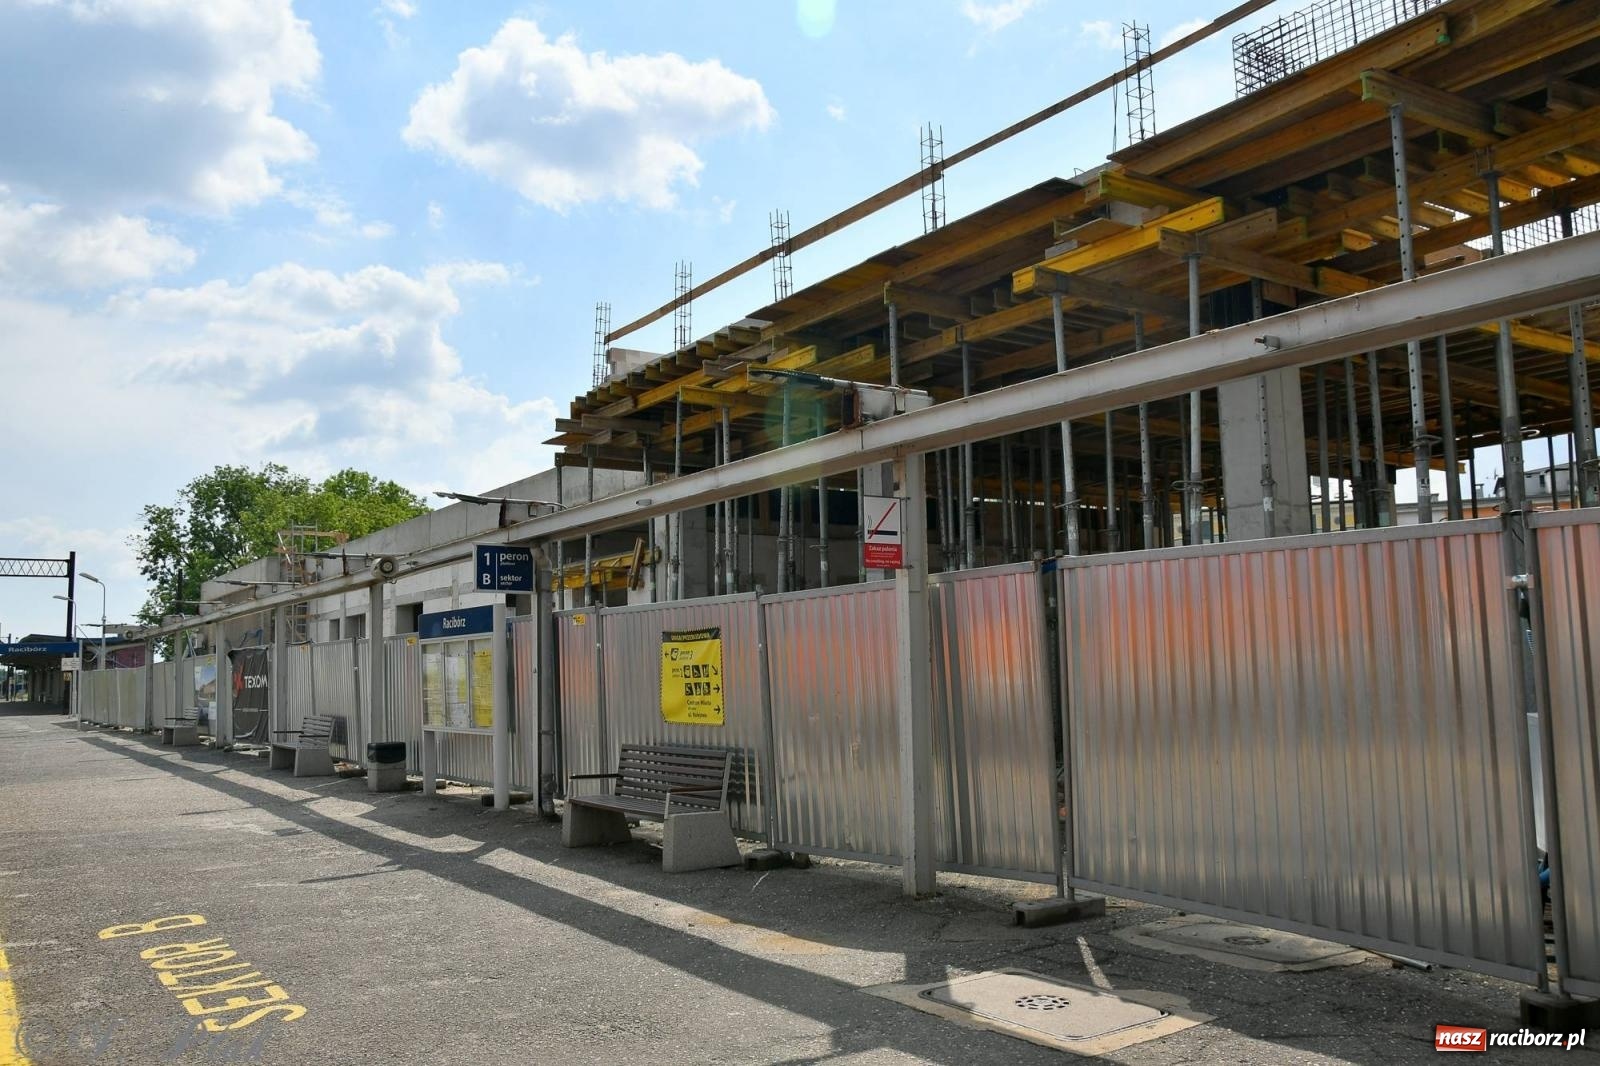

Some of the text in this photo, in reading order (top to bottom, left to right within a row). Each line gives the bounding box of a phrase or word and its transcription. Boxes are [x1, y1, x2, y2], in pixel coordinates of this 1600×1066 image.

[483, 552, 529, 566] 1 peron
[482, 573, 522, 585] B sektor
[442, 616, 466, 629] Racibórz
[244, 675, 268, 689] TEXOM
[97, 914, 308, 1032] SEKTOR B
